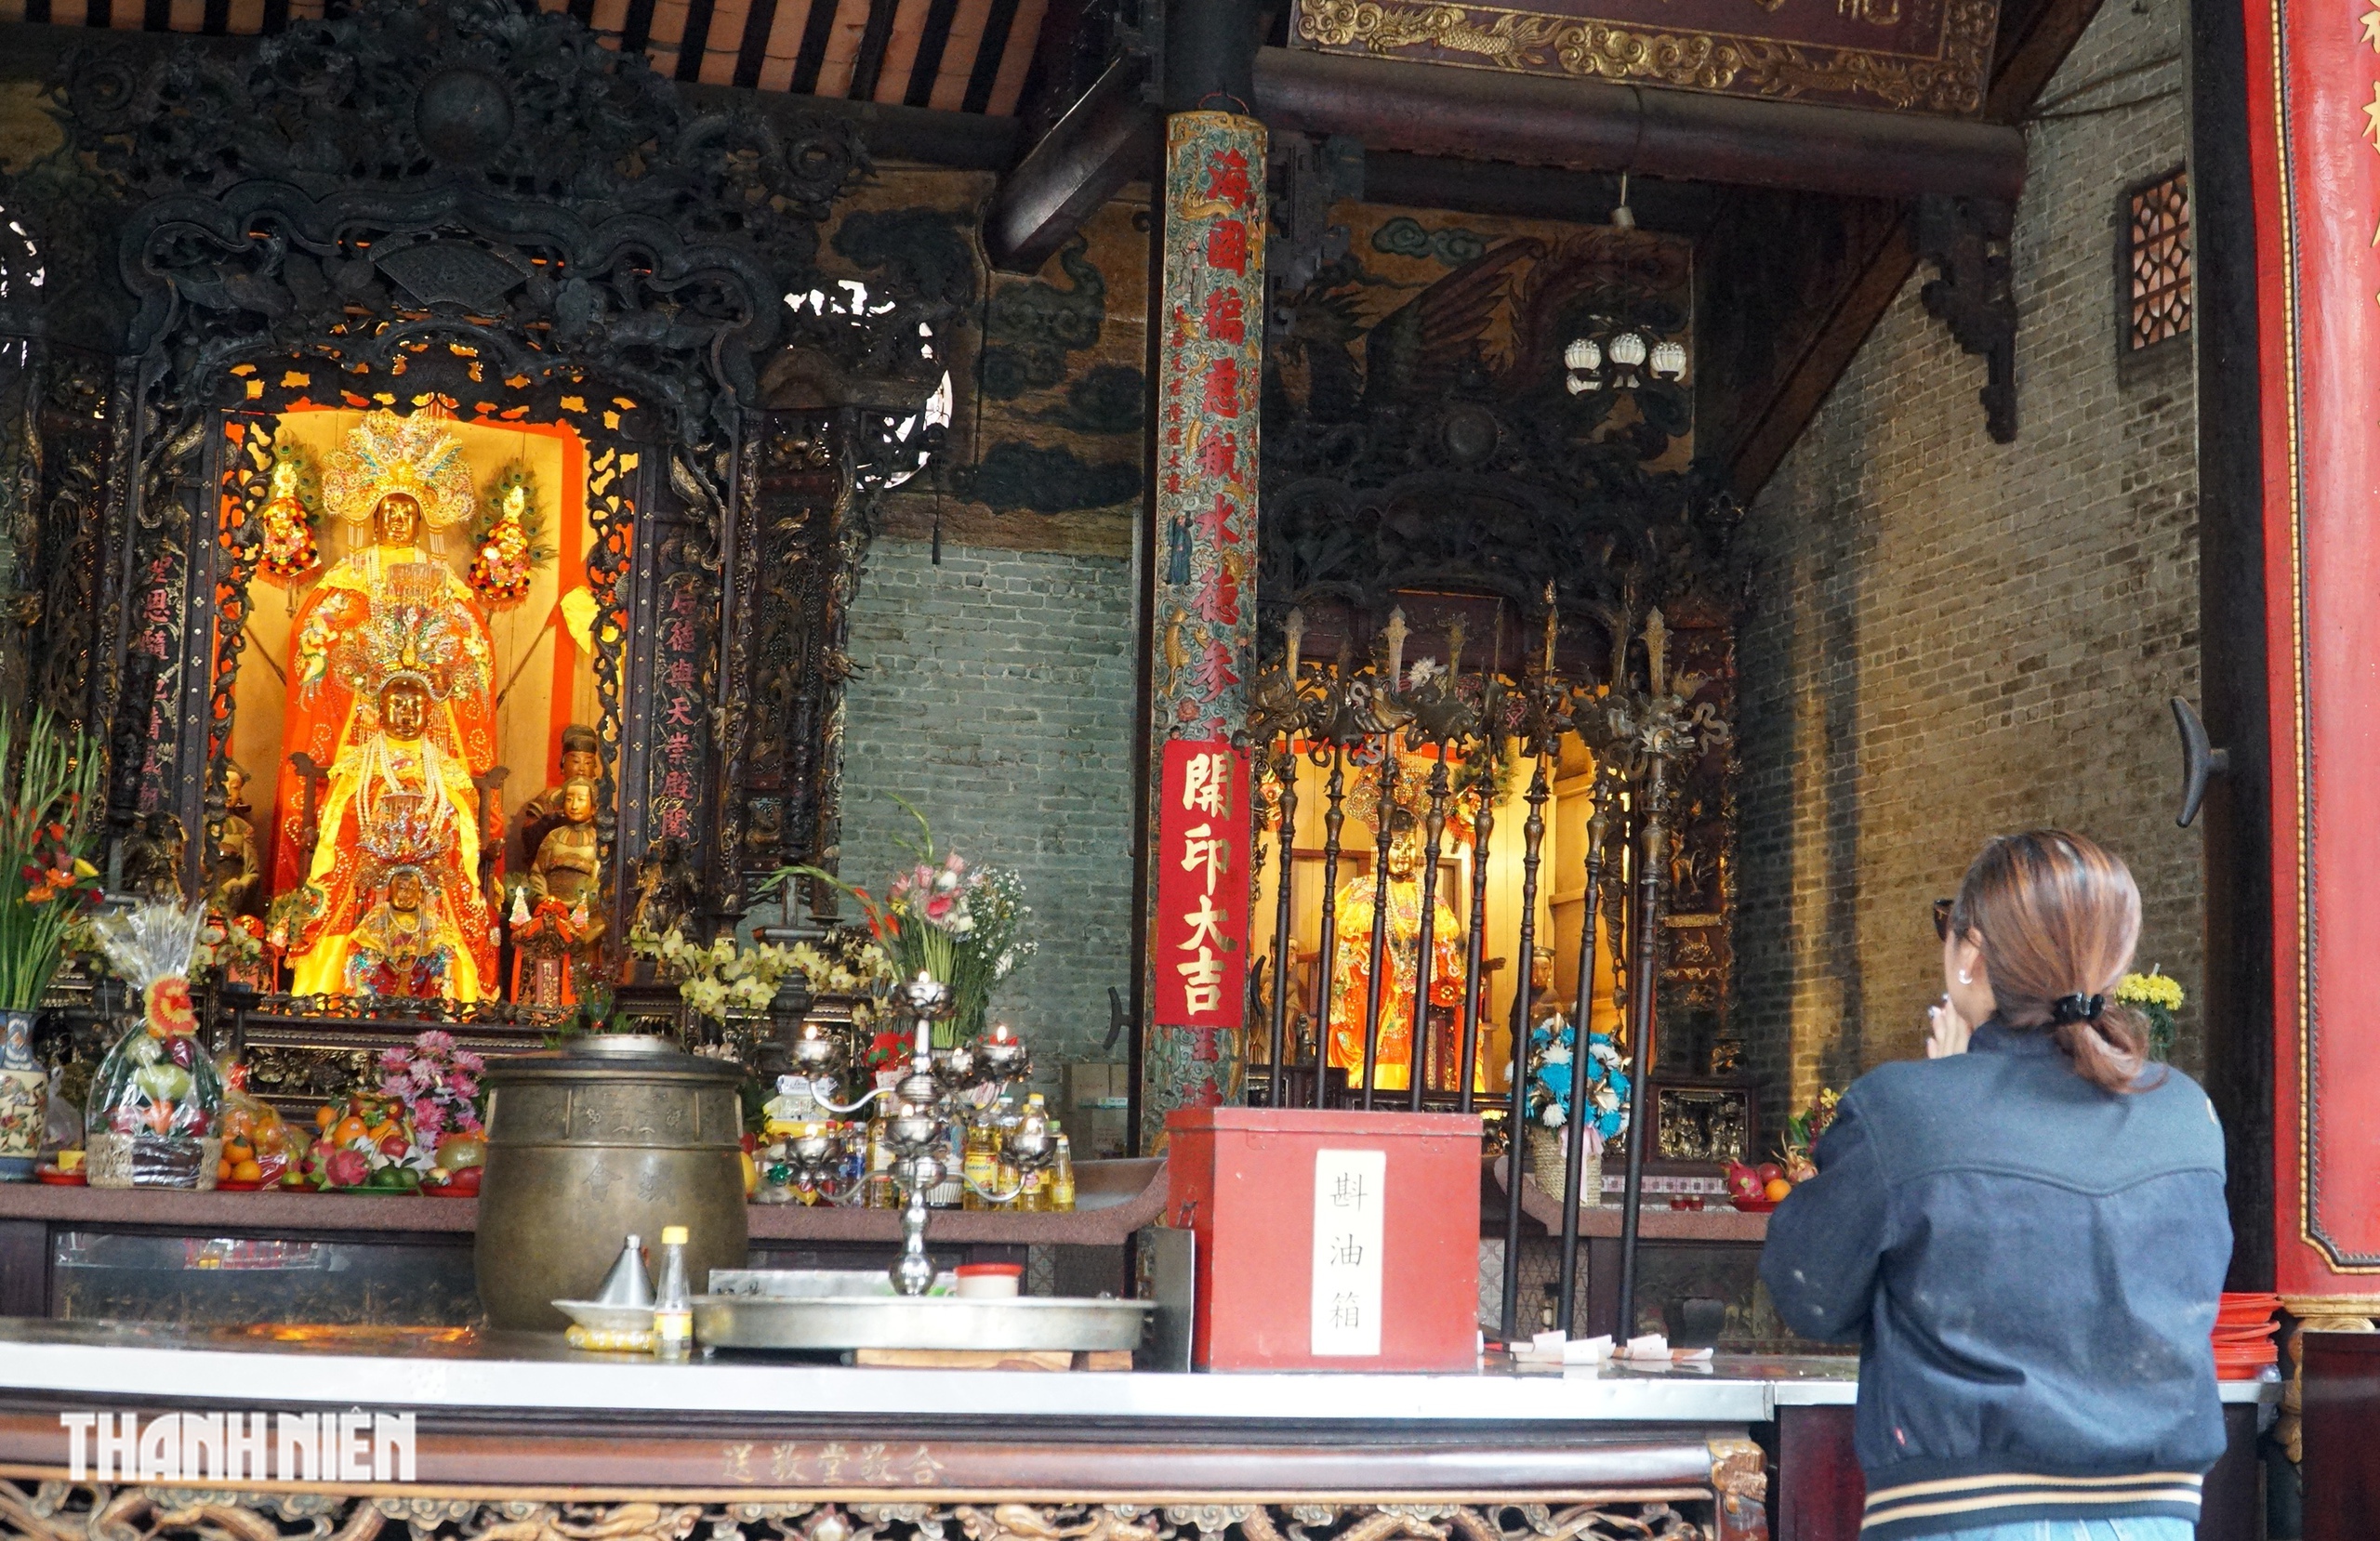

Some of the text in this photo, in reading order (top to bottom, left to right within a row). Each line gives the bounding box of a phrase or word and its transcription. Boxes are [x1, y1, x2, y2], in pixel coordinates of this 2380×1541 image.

[1176, 749, 1237, 1016] 開印大吉
[1329, 1172, 1368, 1329] 斟油箱
